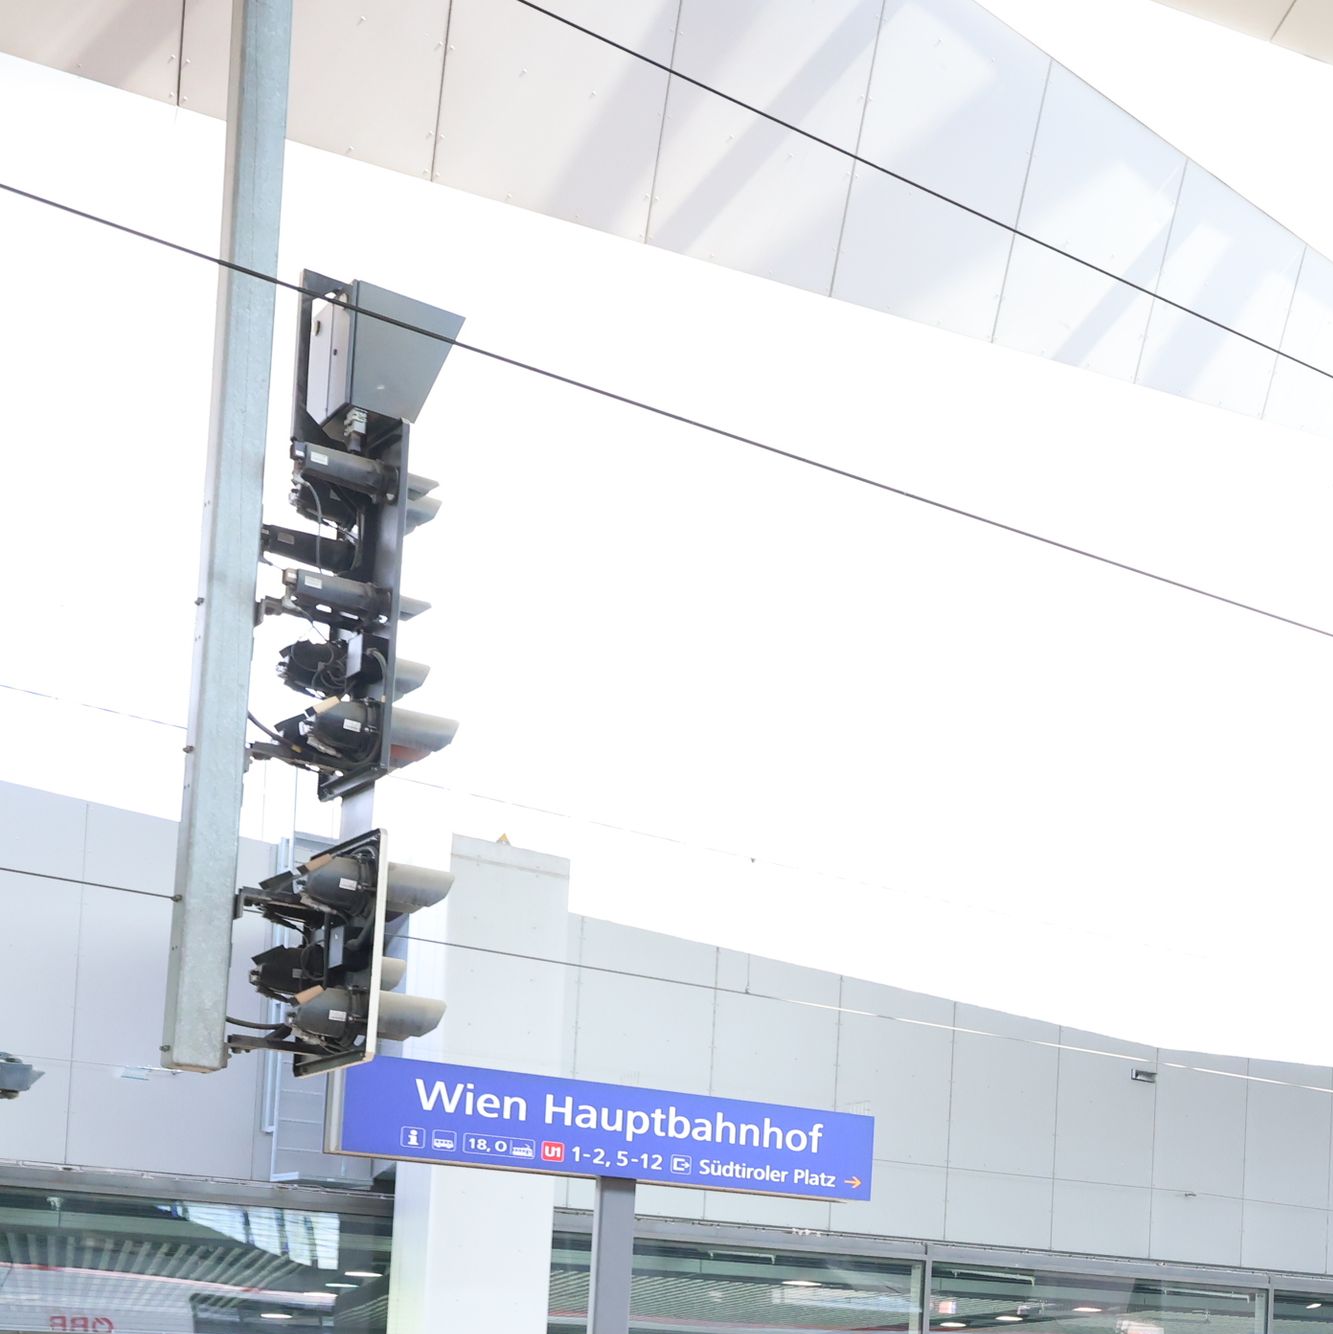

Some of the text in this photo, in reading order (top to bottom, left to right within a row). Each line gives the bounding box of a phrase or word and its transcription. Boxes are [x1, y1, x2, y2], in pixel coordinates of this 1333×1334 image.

[415, 1078, 824, 1153] Wien Hauptbahnhof
[468, 1136, 491, 1153] 18,
[544, 1144, 562, 1160] U1
[571, 1147, 610, 1168] 1-2,
[617, 1151, 662, 1171] 5-12
[699, 1157, 789, 1184] Südtiroler
[793, 1168, 836, 1188] Platz
